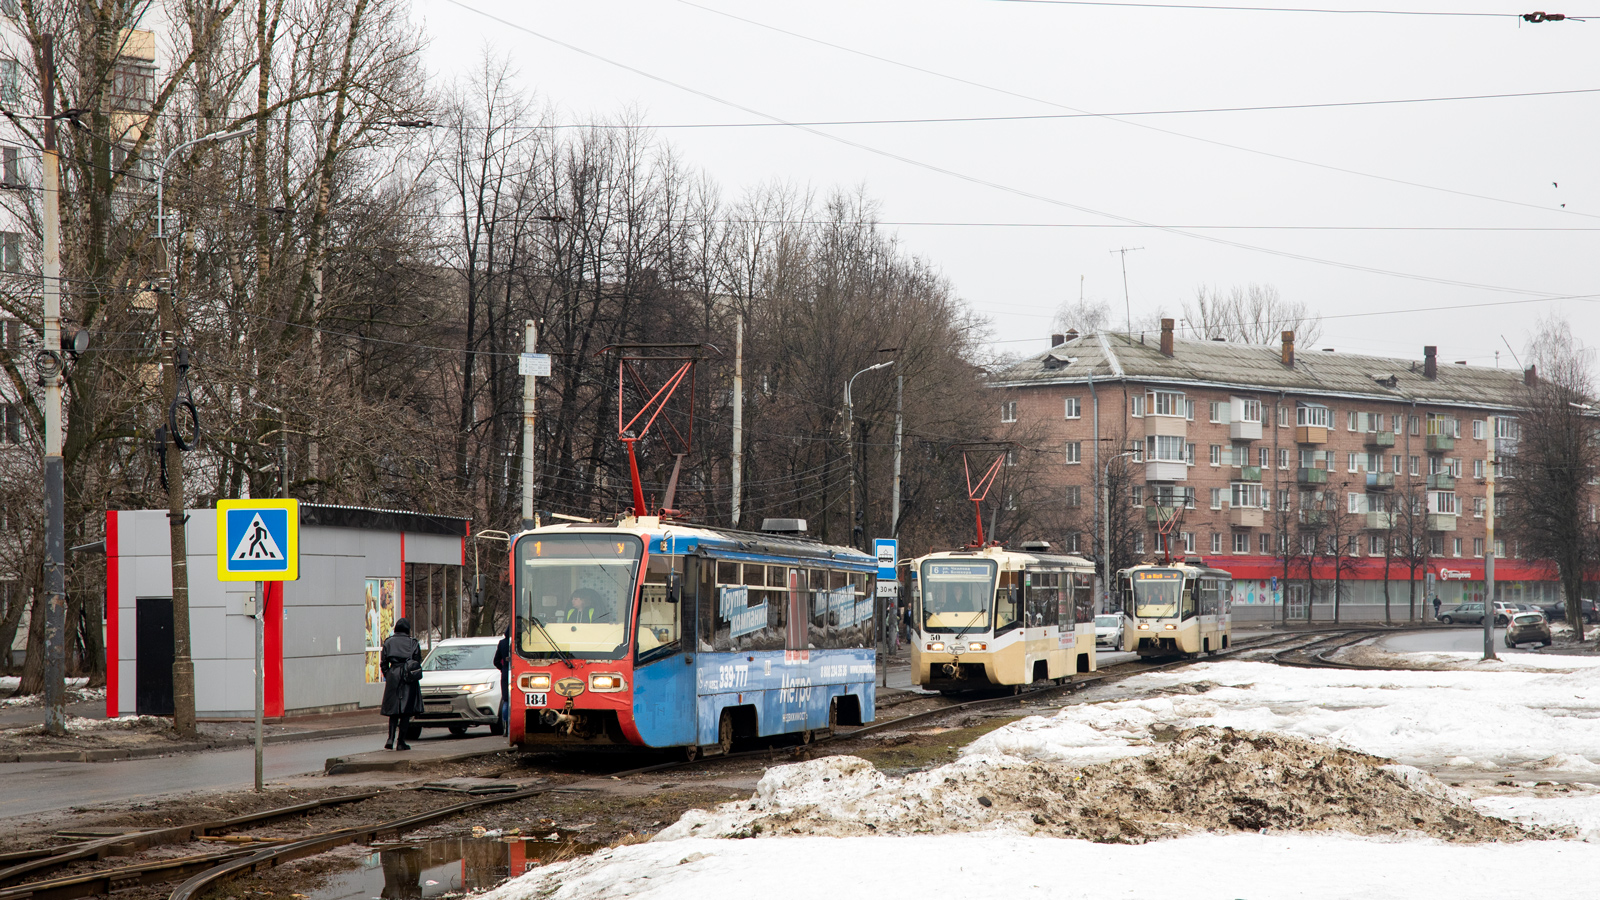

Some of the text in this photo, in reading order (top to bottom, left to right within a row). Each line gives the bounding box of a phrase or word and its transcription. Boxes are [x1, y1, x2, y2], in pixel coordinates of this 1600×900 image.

[534, 541, 542, 556] 1
[933, 566, 940, 574] 6
[720, 587, 748, 618] Группа
[719, 665, 749, 689] 339-777
[525, 694, 547, 706] 184
[779, 673, 812, 708] Метро
